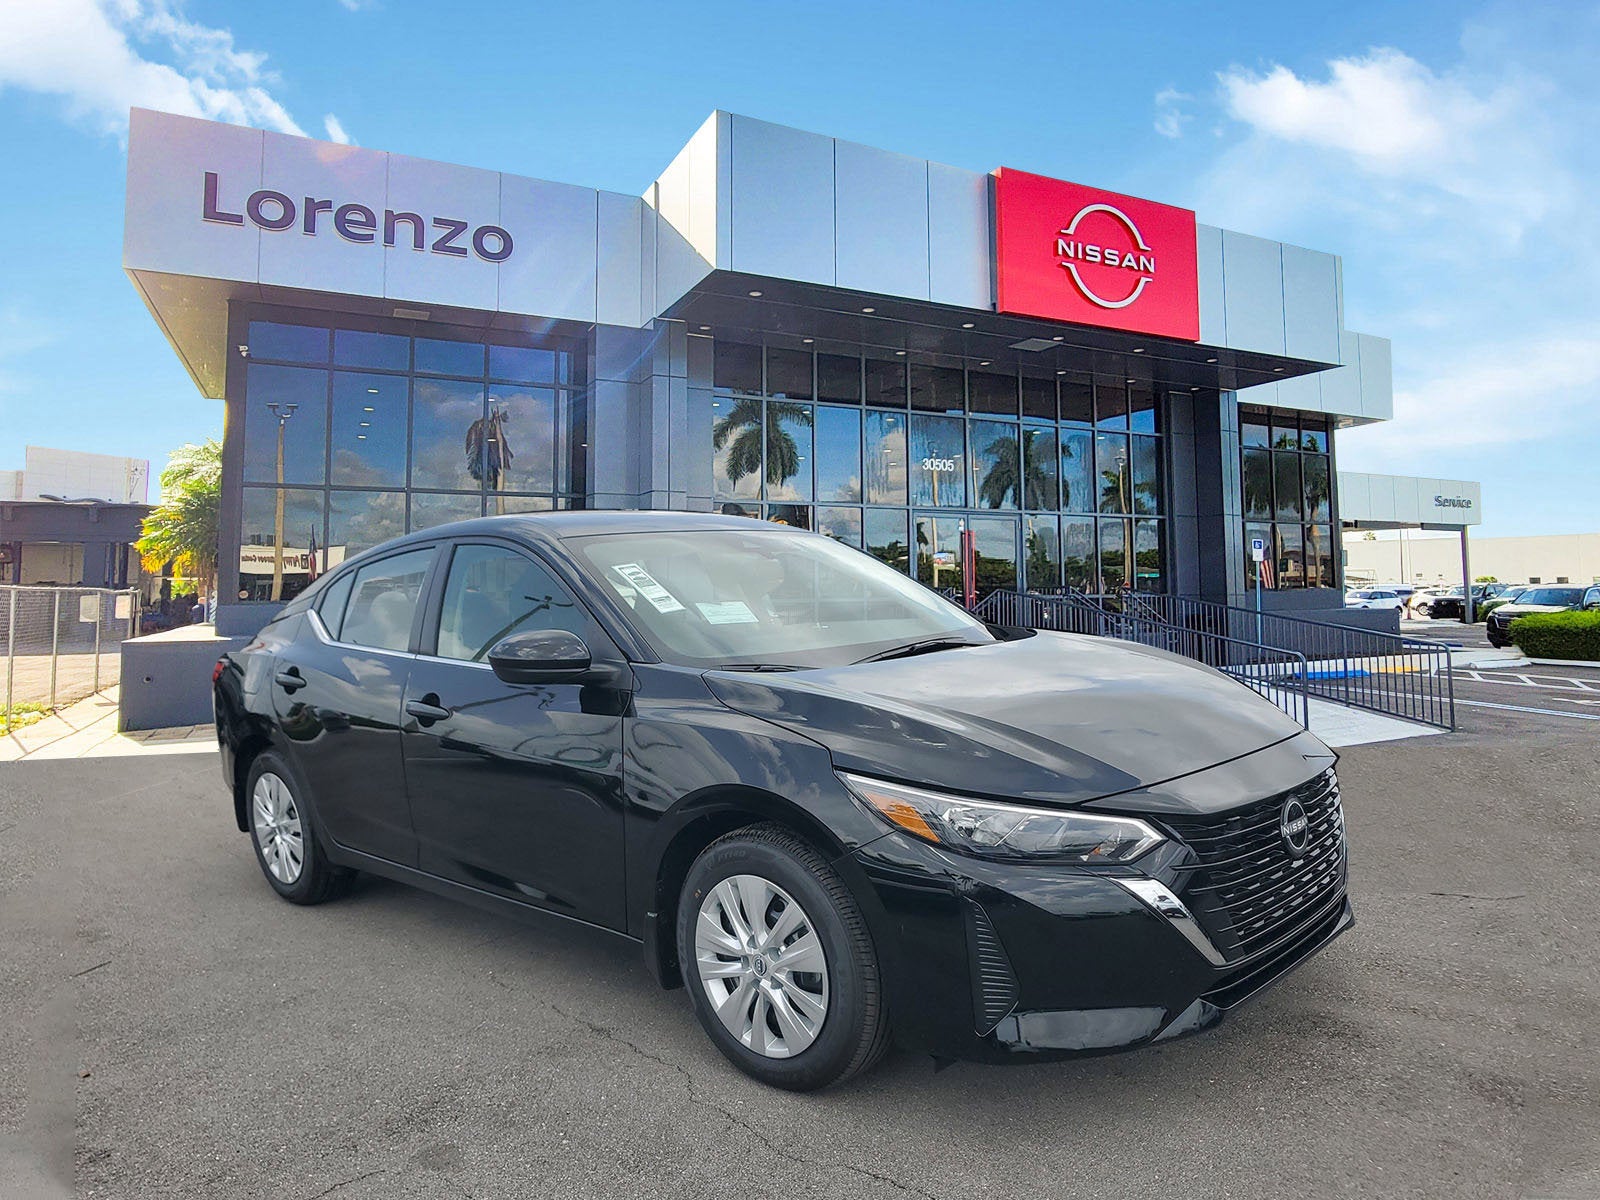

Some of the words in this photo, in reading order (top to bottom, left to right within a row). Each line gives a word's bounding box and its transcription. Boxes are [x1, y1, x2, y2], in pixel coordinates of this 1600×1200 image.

[202, 171, 514, 262] Lorenzo
[1057, 238, 1155, 273] NISSAN
[922, 457, 955, 472] 30505
[1434, 495, 1472, 508] Service
[1283, 816, 1308, 835] NISSAN
